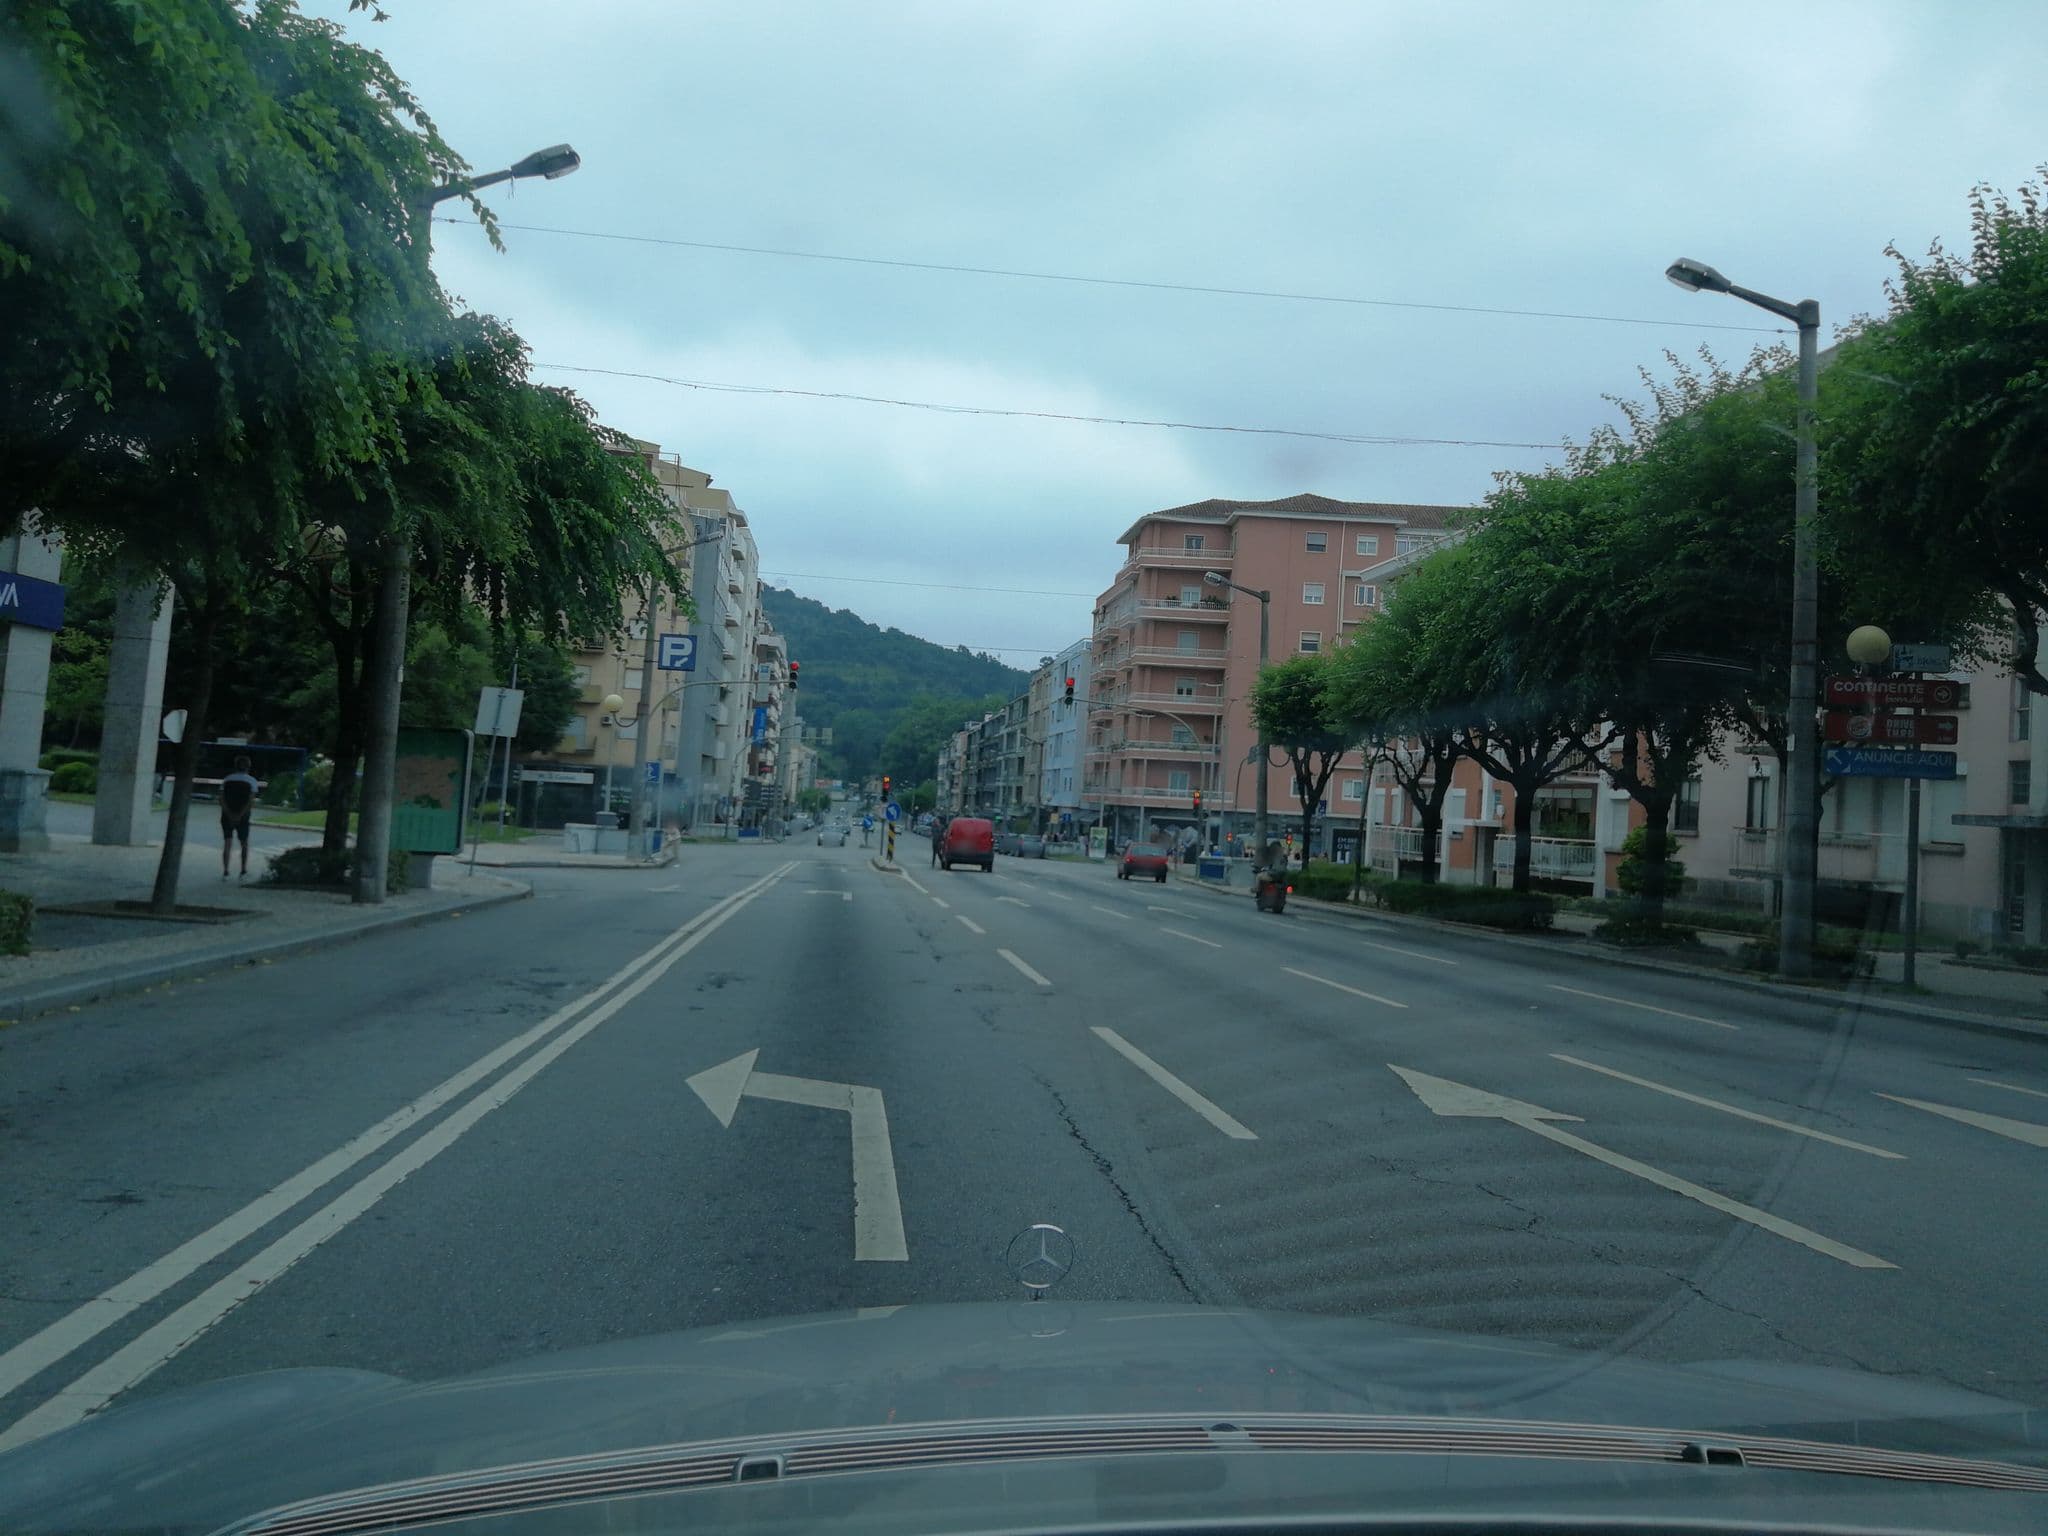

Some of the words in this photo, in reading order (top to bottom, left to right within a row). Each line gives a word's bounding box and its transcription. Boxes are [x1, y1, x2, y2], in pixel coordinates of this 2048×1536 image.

[662, 637, 692, 666] P
[1854, 752, 1913, 765] ANUNCIE
[1918, 754, 1953, 767] AQUI
